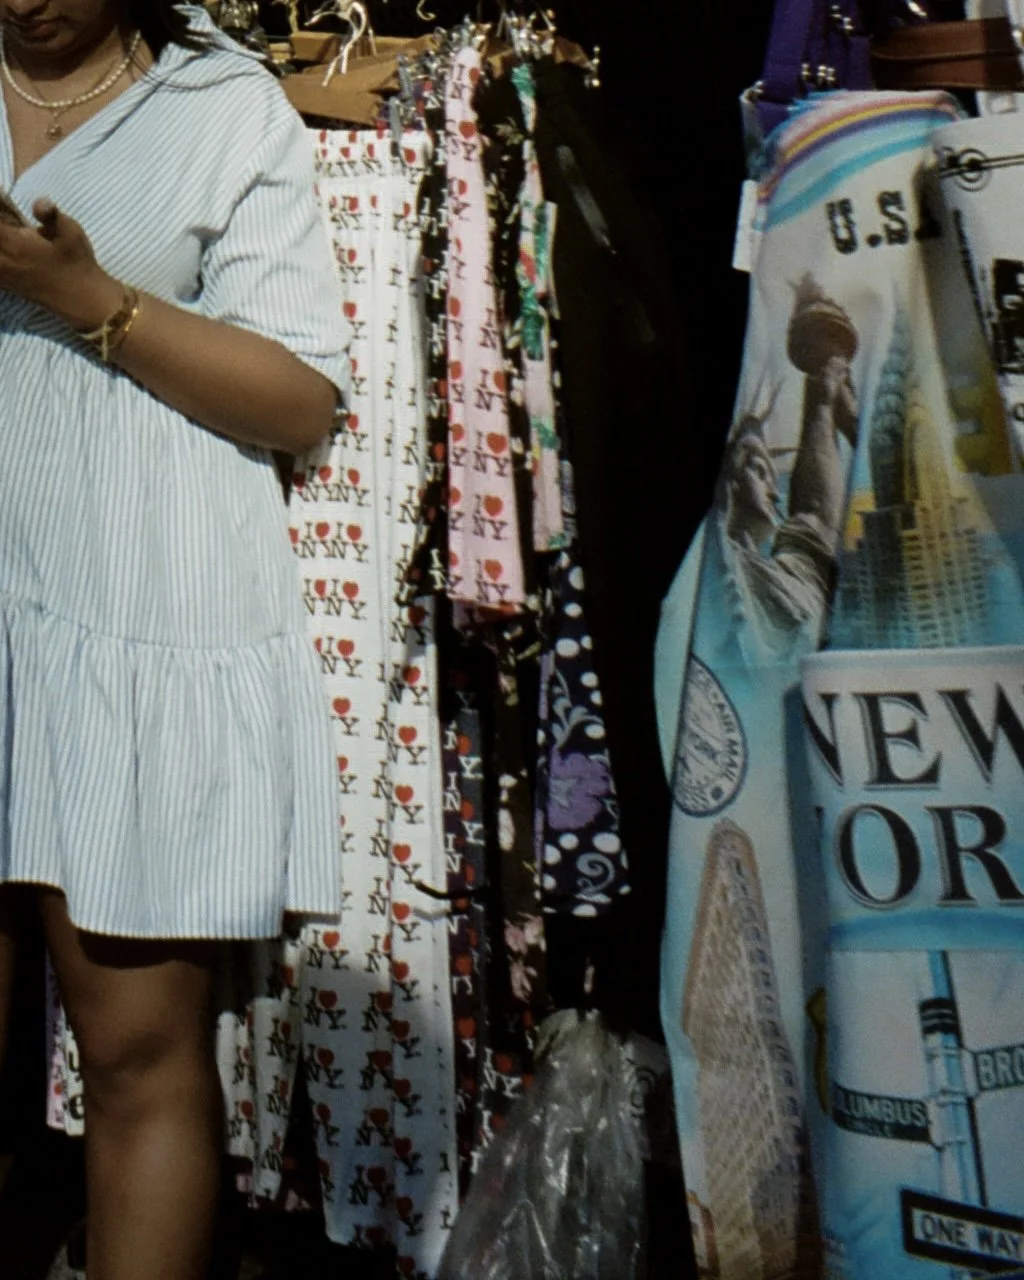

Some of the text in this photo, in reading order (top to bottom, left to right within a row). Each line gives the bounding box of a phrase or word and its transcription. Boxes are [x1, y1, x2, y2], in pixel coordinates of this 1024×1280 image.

[326, 637, 334, 654] I
[321, 655, 362, 677] NY
[815, 802, 1024, 910] OR
[307, 947, 349, 969] NY
[921, 1213, 1022, 1258] ONE WAY
